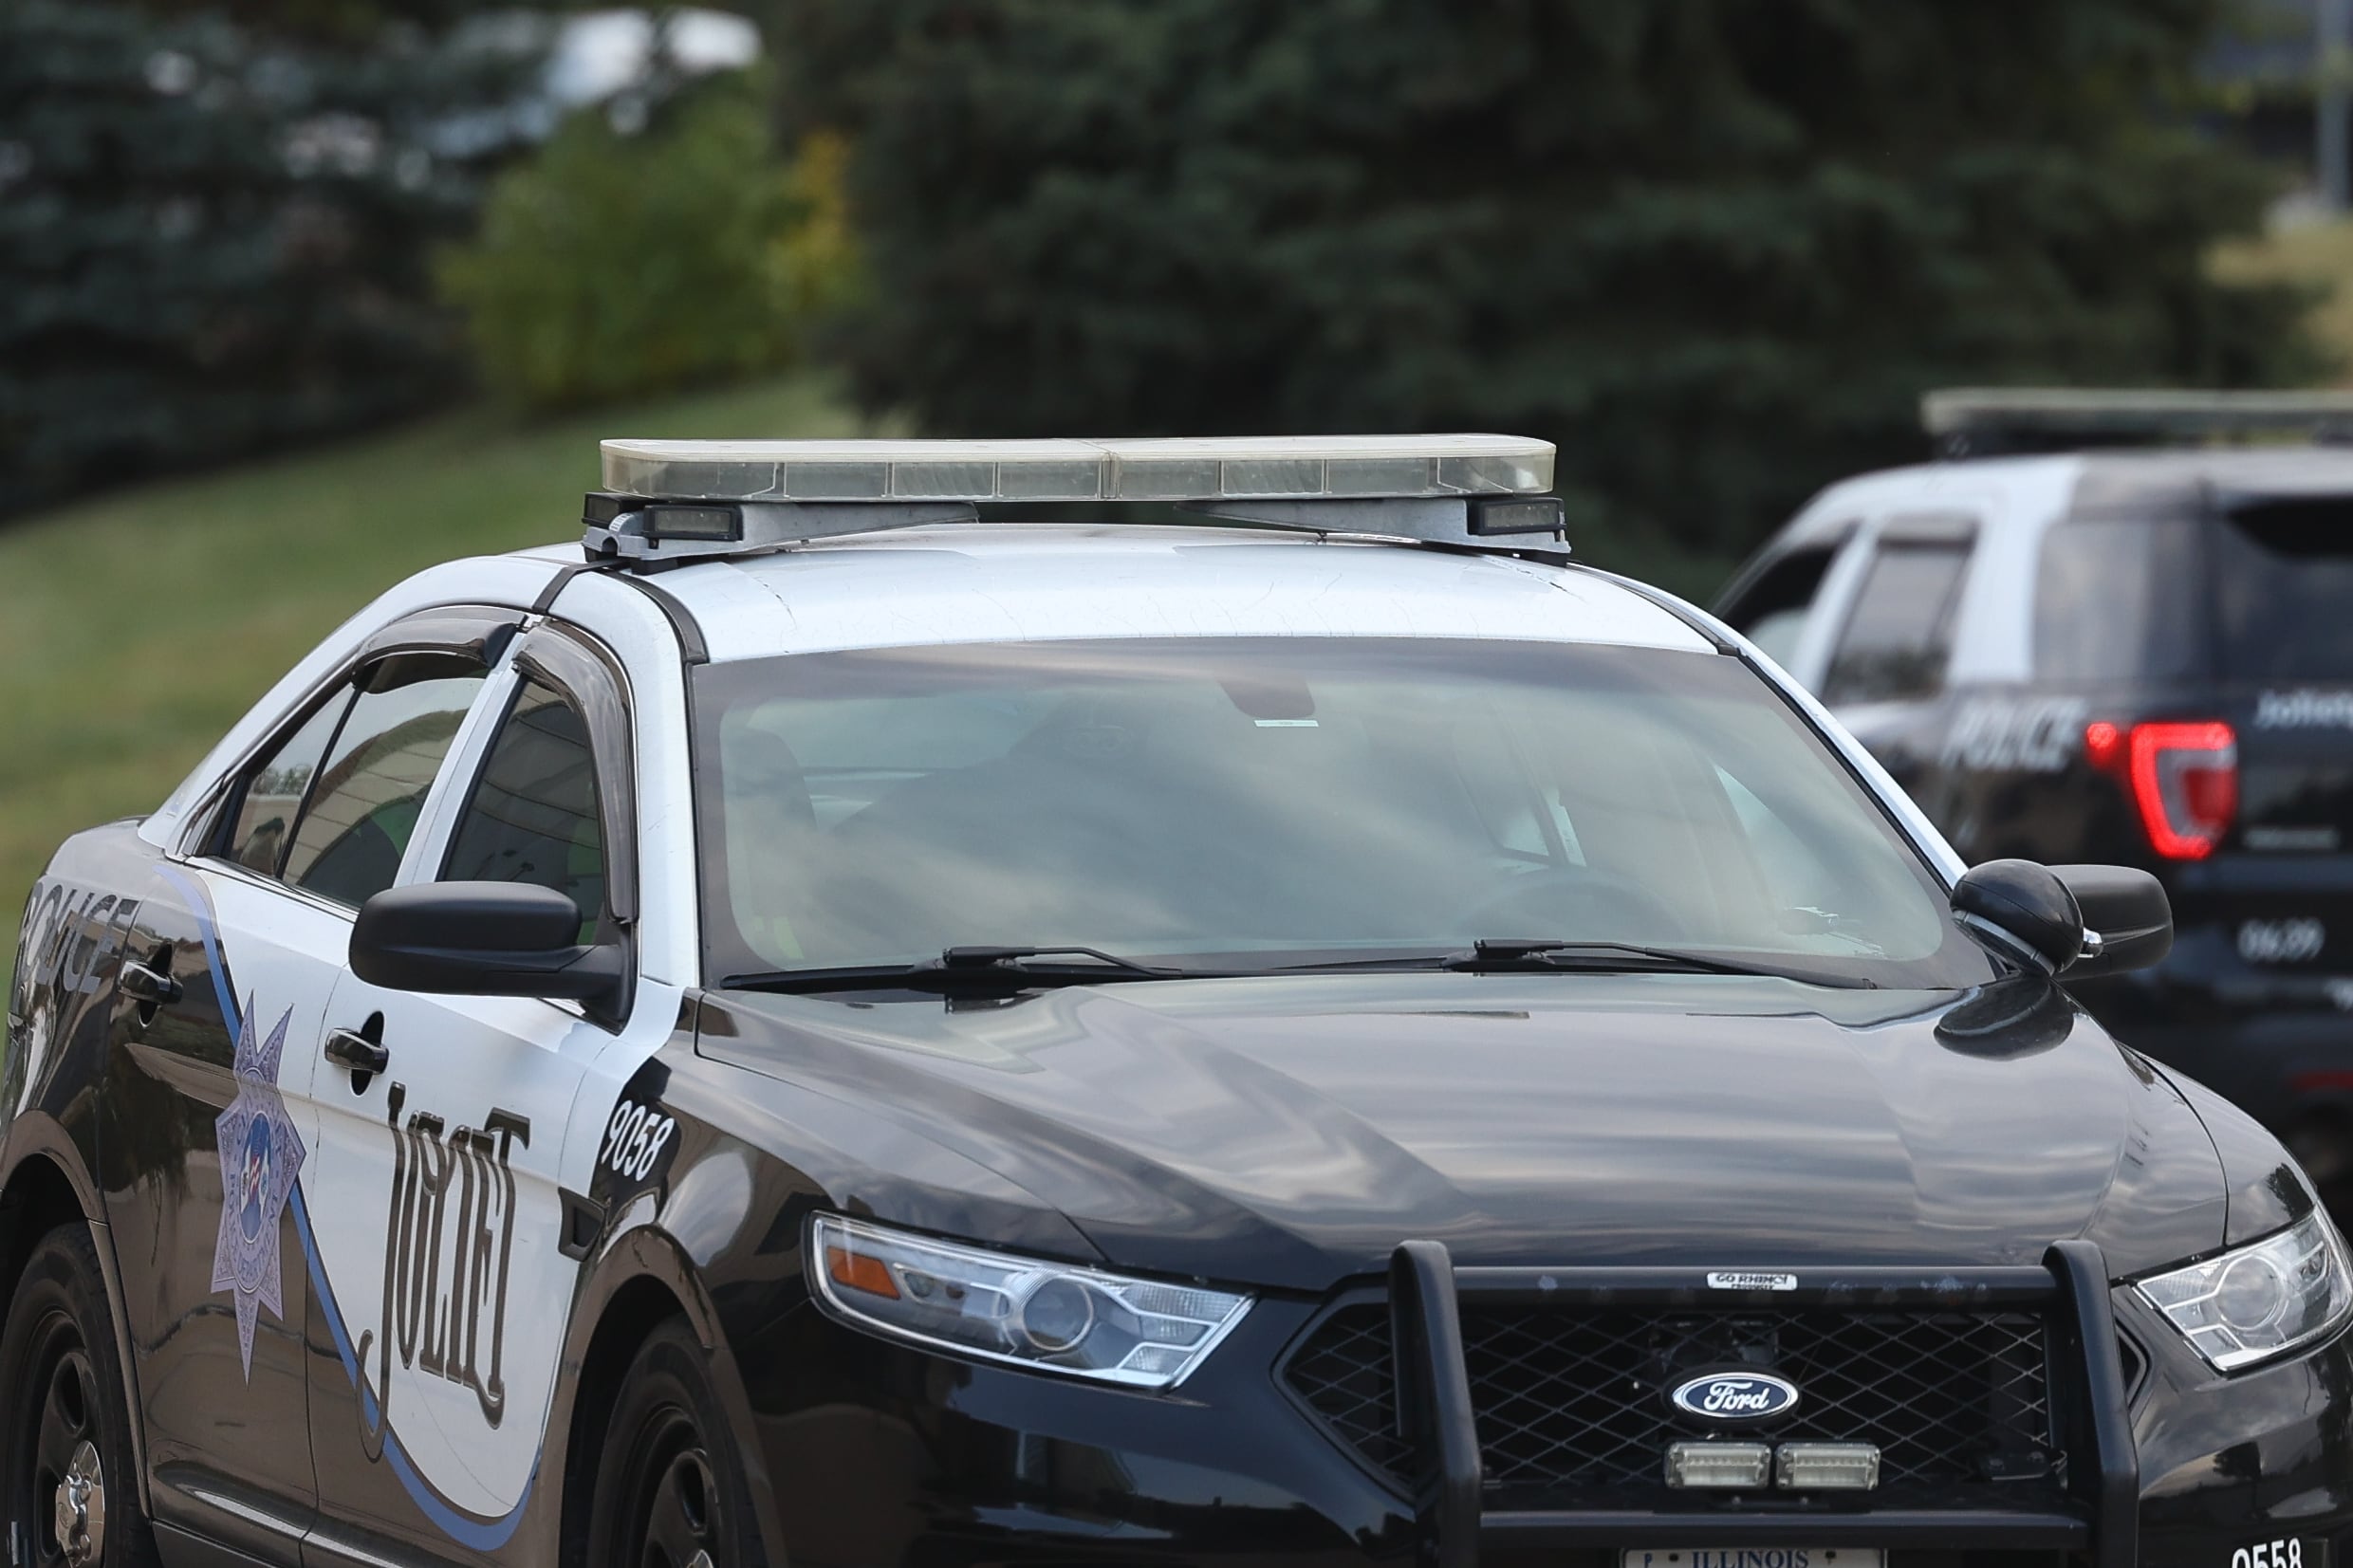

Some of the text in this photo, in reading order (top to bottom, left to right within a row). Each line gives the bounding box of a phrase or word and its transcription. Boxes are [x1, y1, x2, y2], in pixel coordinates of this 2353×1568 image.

[22, 883, 140, 994] POLICE
[602, 1099, 675, 1182] 9058
[357, 1080, 530, 1462] JOLIET
[1715, 1274, 1735, 1283] GO
[1704, 1381, 1770, 1411] Ford
[1692, 1550, 1809, 1568] ILLINOIS
